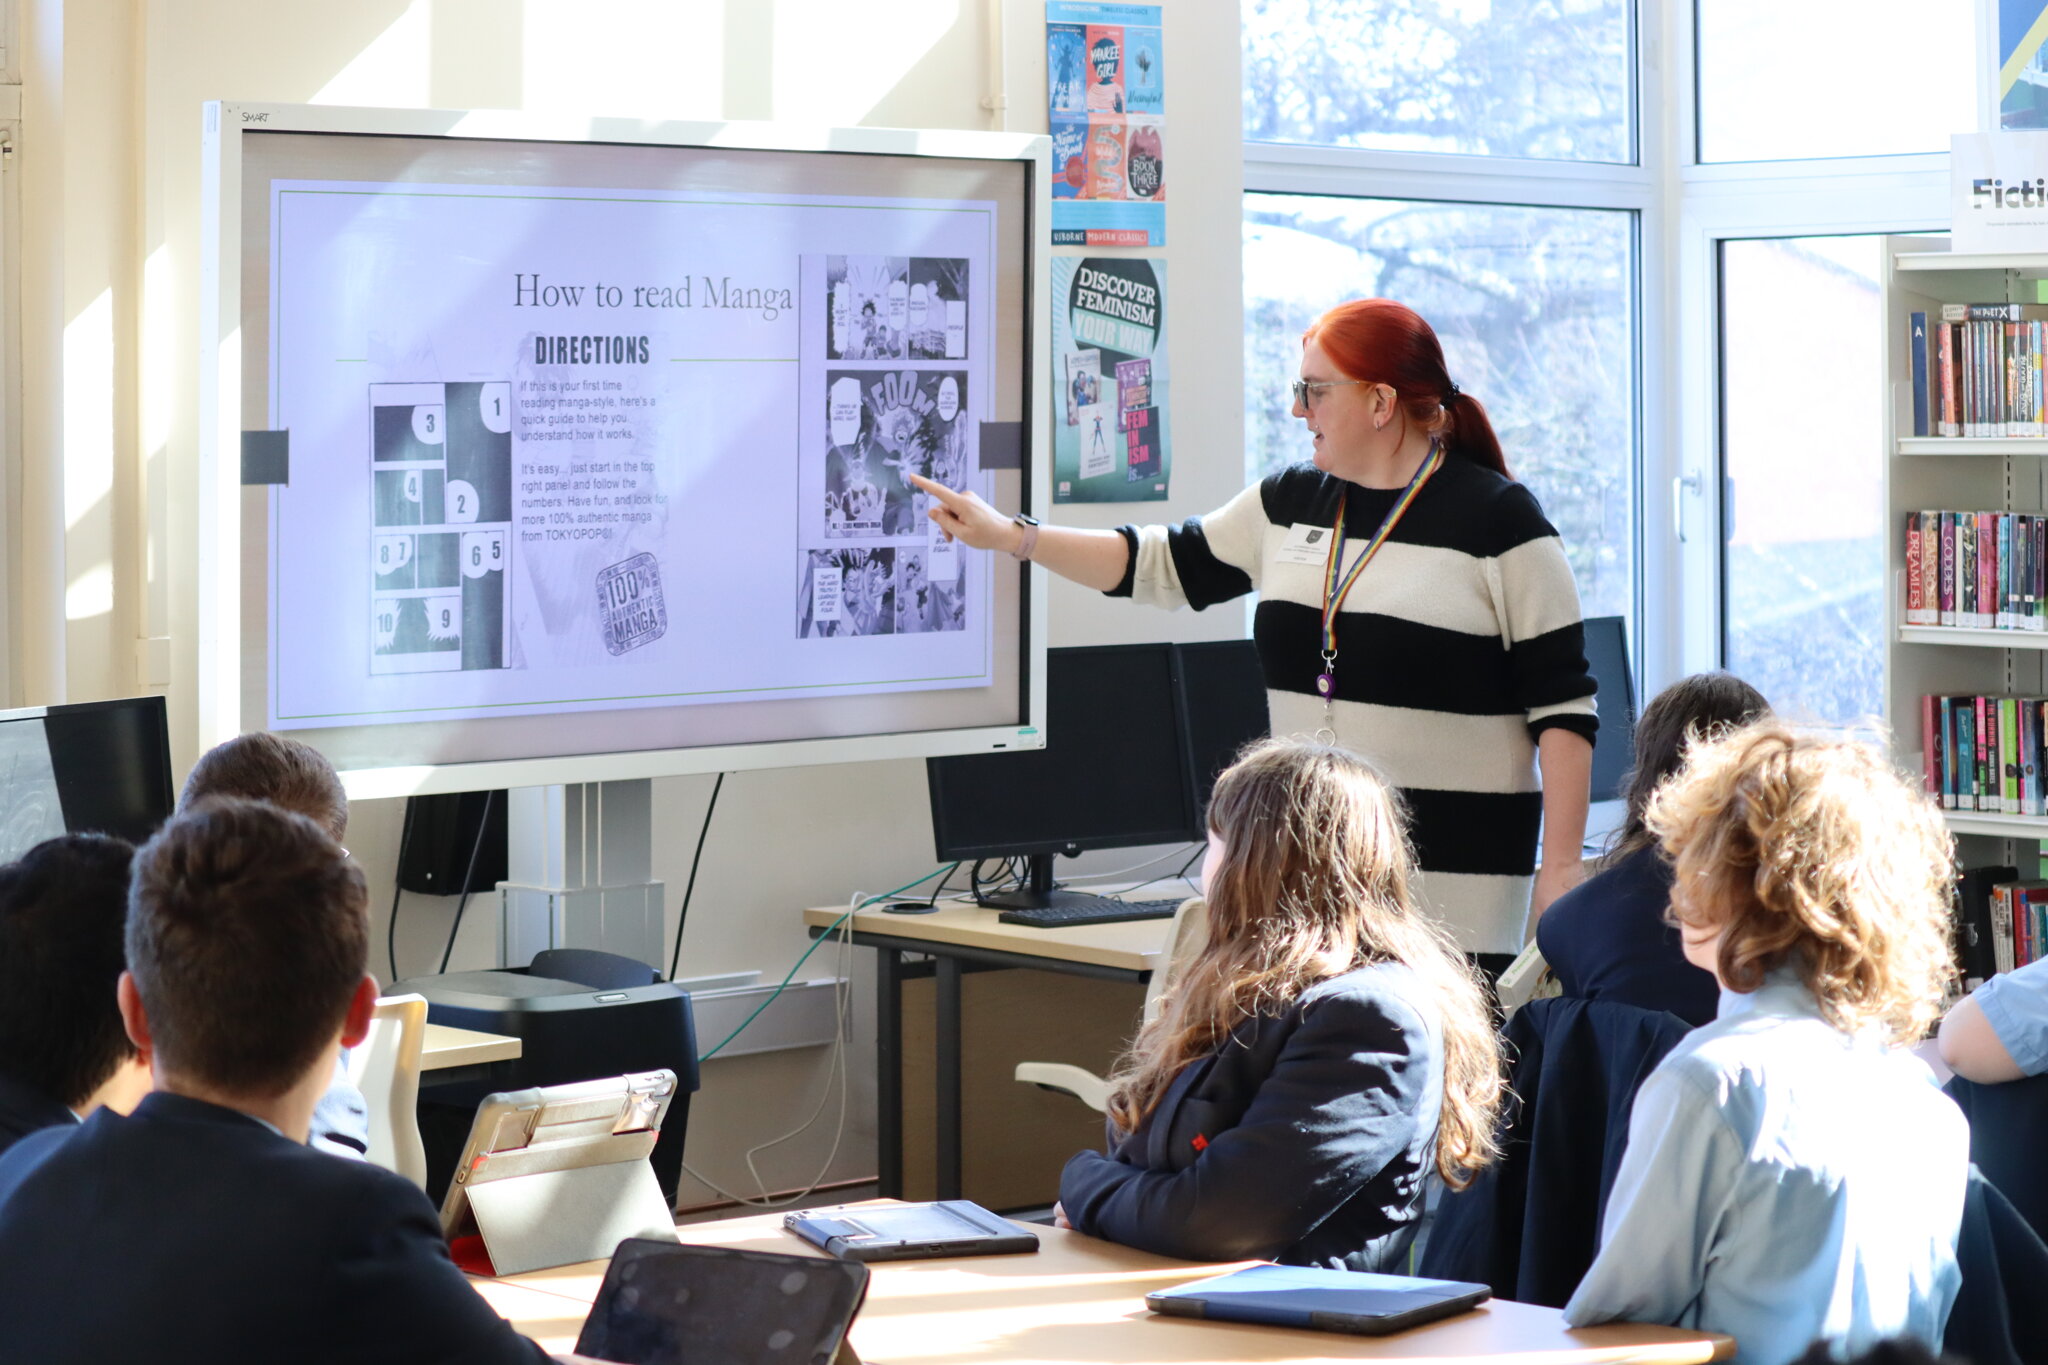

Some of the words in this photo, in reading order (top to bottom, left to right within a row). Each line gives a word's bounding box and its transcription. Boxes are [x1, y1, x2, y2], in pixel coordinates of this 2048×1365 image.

[1091, 45, 1120, 62] YANKEE
[1096, 62, 1115, 78] GIRL
[242, 112, 269, 122] SMART
[1133, 159, 1157, 176] BOOK
[1130, 172, 1159, 189] THREE
[1973, 178, 2048, 209] Ficti
[1053, 231, 1084, 241] USBORNE
[1087, 232, 1117, 241] MODERN
[1079, 267, 1155, 306] DISCOVER
[513, 273, 585, 308] How
[595, 281, 623, 308] to
[633, 275, 693, 308] read
[702, 276, 793, 321] Manga
[1076, 288, 1155, 326] FEMINISM
[1999, 306, 2008, 319] X
[1074, 313, 1116, 346] YOUR
[1119, 324, 1153, 354] WAY
[1915, 326, 1923, 337] A
[535, 335, 649, 365] DIRECTIONS
[520, 381, 528, 391] If
[529, 381, 547, 391] this
[549, 381, 557, 391] is
[559, 382, 580, 393] your
[582, 380, 600, 391] first
[602, 380, 622, 390] time
[870, 370, 936, 416] FOOM
[494, 397, 501, 416] 1
[520, 397, 556, 410] reading
[558, 397, 617, 409] manga-style,
[620, 396, 648, 406] here's
[650, 398, 656, 406] a
[426, 414, 434, 433] 3
[521, 414, 546, 426] quick
[548, 414, 574, 425] guide
[576, 414, 586, 423] to
[588, 413, 608, 425] help
[610, 415, 628, 425] you
[1126, 409, 1148, 429] FEM
[521, 430, 573, 441] understand
[576, 430, 595, 439] how
[599, 429, 603, 439] it
[606, 429, 635, 439] works.
[1128, 429, 1139, 447] IN
[1128, 445, 1149, 465] ISM
[521, 463, 535, 474] It's
[570, 463, 588, 475] just
[590, 462, 610, 472] start
[613, 462, 621, 472] in
[623, 462, 638, 472] the
[640, 461, 655, 472] top
[408, 477, 417, 495] 4
[521, 480, 542, 493] right
[545, 480, 571, 491] panel
[573, 479, 590, 490] and
[593, 478, 619, 489] follow
[622, 478, 636, 488] the
[457, 495, 466, 514] 2
[567, 496, 591, 506] Have
[614, 495, 632, 505] and
[633, 494, 651, 505] look
[521, 514, 545, 525] more
[549, 513, 574, 524] 100%
[577, 512, 620, 523] authentic
[621, 512, 652, 524] manga
[521, 530, 542, 541] from
[381, 545, 389, 564] 8
[399, 542, 406, 560] 7
[472, 546, 481, 566] 6
[492, 541, 500, 559] 5
[608, 569, 651, 608] 100%
[378, 613, 392, 633] 10
[442, 609, 450, 628] 9
[614, 608, 658, 641] MANGA
[1987, 717, 1996, 747] BURNING
